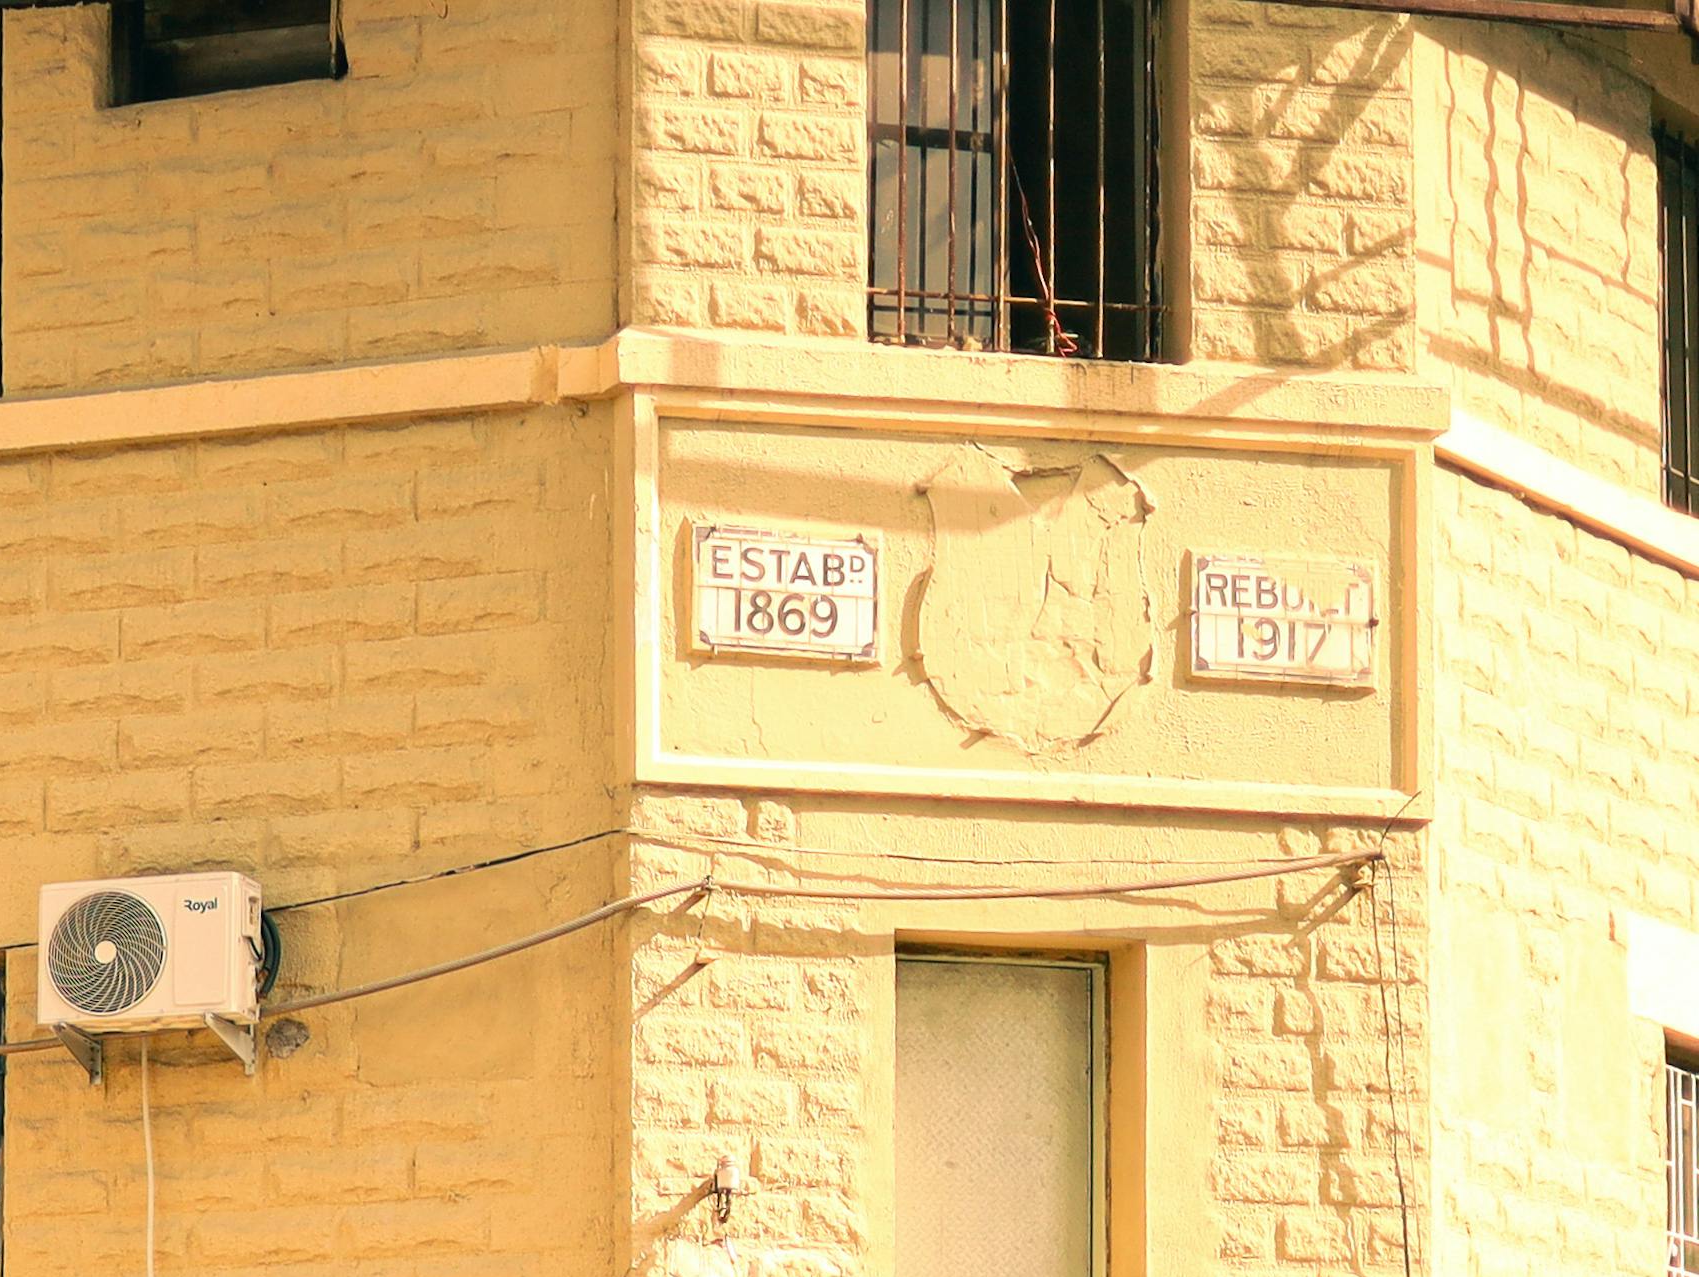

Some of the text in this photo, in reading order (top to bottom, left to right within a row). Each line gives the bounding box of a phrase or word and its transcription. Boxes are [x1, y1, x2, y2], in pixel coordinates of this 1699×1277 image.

[734, 589, 838, 639] 1869
[1236, 617, 1332, 664] 1917
[183, 897, 218, 914] Royal
